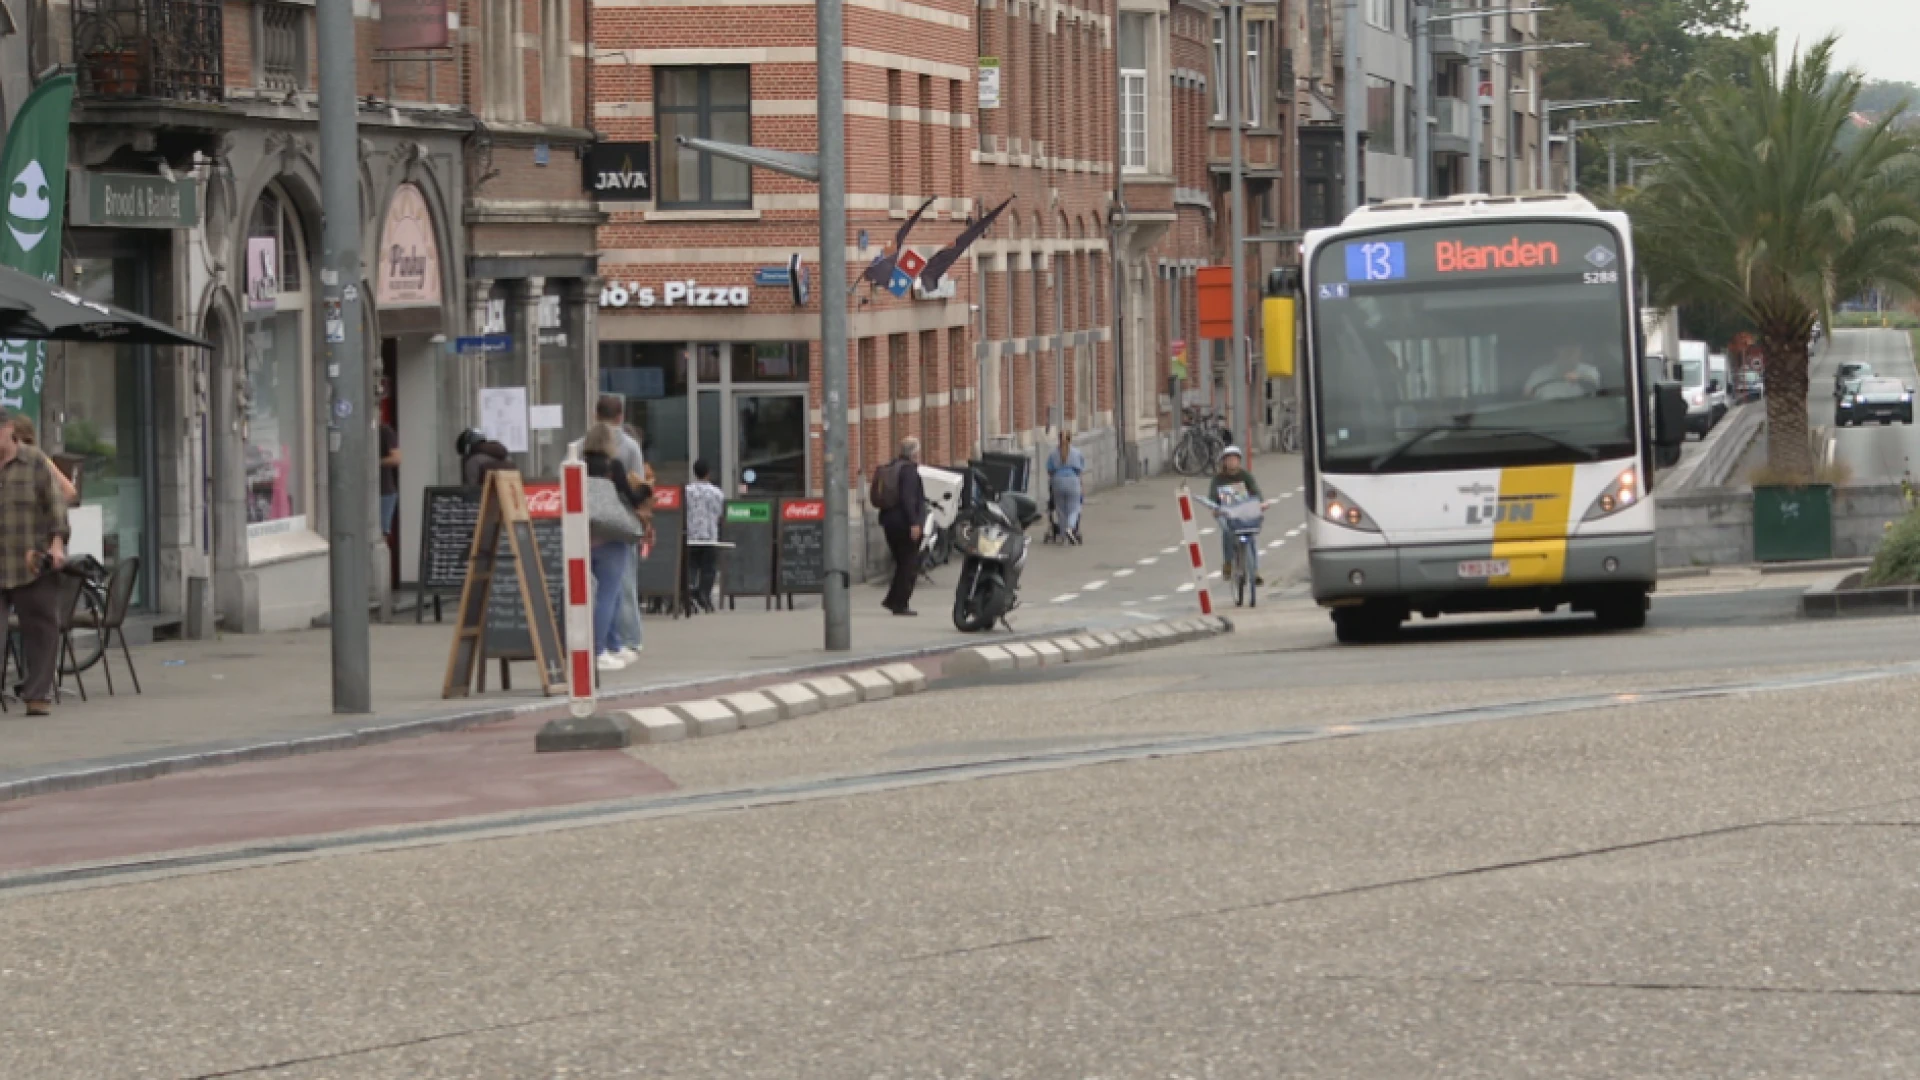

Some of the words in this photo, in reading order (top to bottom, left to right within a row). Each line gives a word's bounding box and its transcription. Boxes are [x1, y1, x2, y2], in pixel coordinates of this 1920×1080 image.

[594, 172, 648, 190] JAVA
[105, 184, 136, 216] Brood
[137, 188, 145, 216] &
[146, 186, 180, 218] Banket
[1361, 242, 1392, 280] 13
[1435, 237, 1558, 272] Blanden
[663, 279, 749, 307] Pizza
